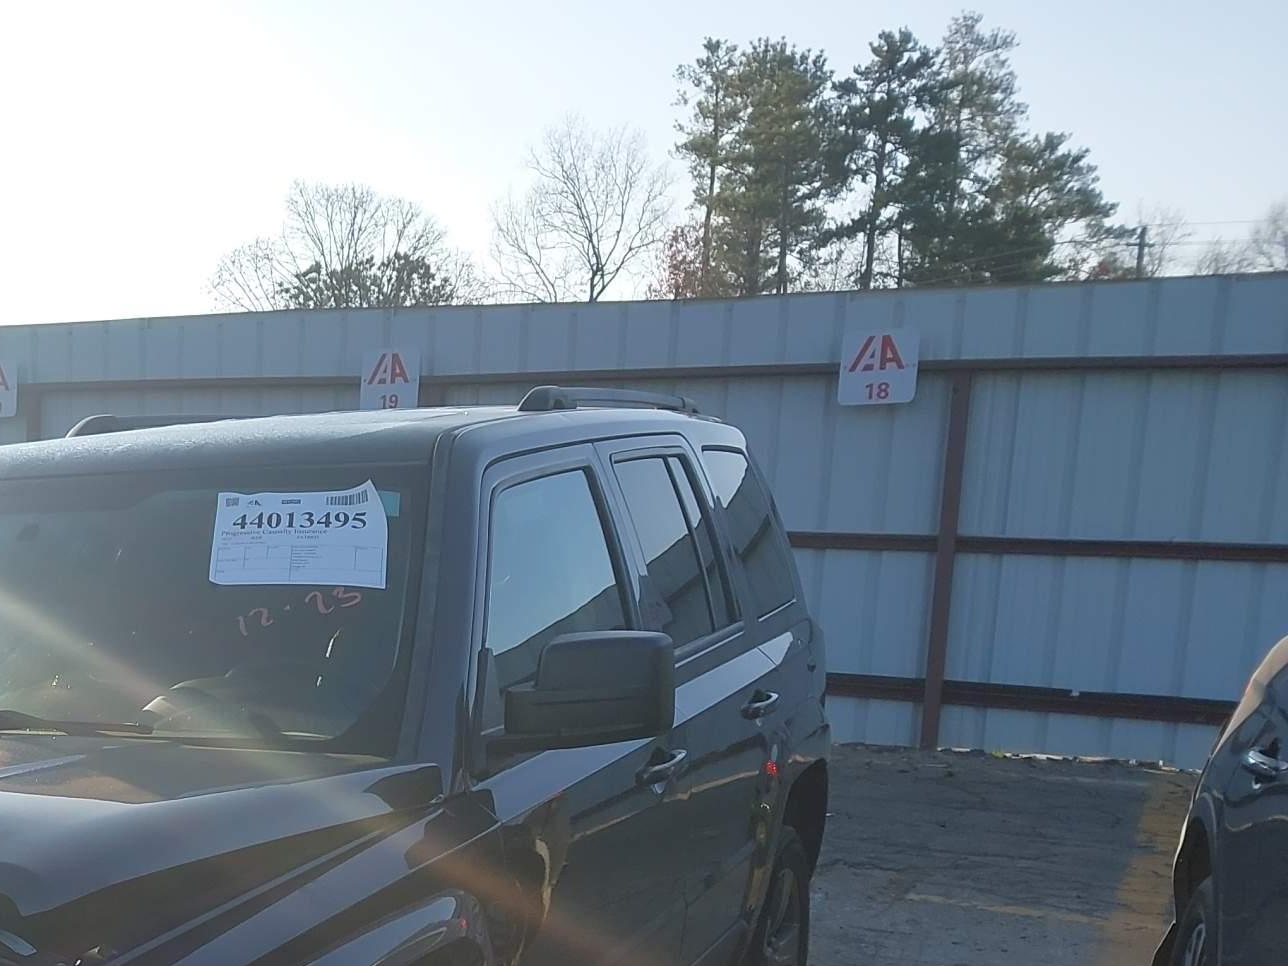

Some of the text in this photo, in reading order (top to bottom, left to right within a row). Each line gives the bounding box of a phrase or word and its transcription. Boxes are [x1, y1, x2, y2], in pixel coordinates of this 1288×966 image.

[865, 382, 890, 401] 18
[379, 394, 399, 409] 19
[232, 511, 368, 529] 44013495
